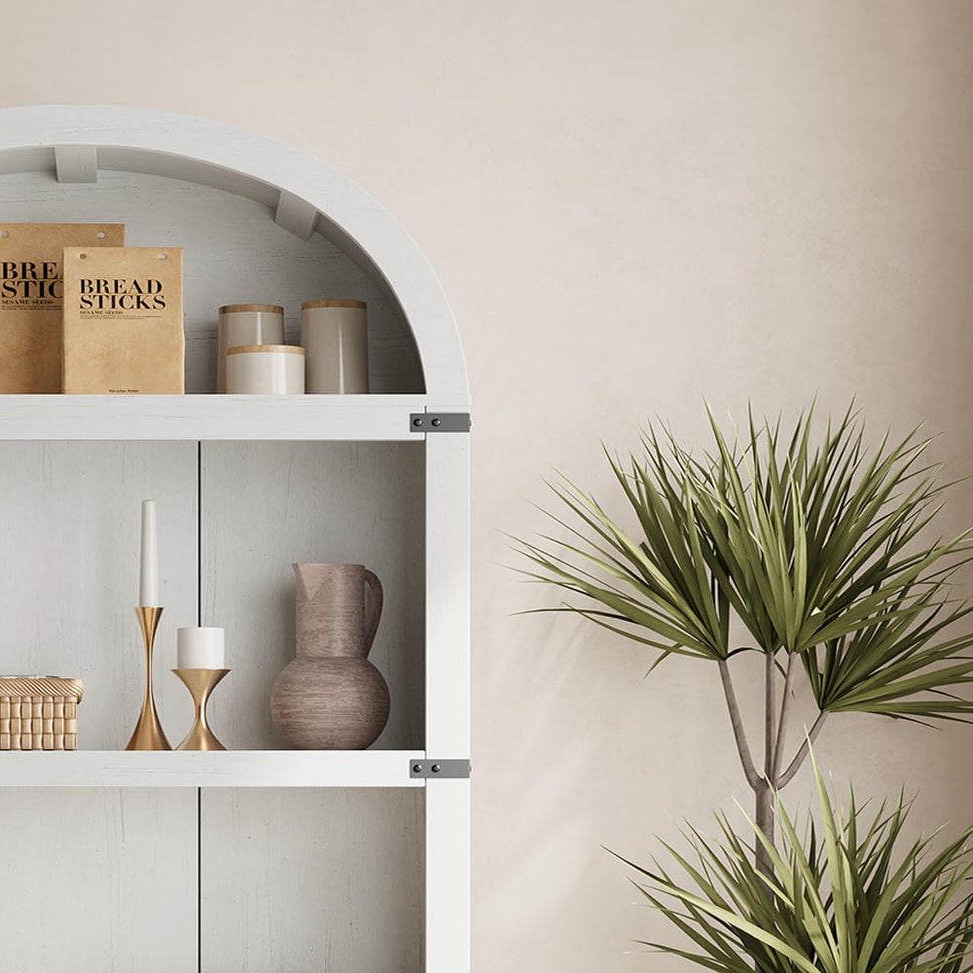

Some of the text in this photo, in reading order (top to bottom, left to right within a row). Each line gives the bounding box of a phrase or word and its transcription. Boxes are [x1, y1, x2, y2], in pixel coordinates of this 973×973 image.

[0, 261, 63, 280] BRE
[79, 279, 163, 294] BREAD
[79, 294, 166, 311] STICKS
